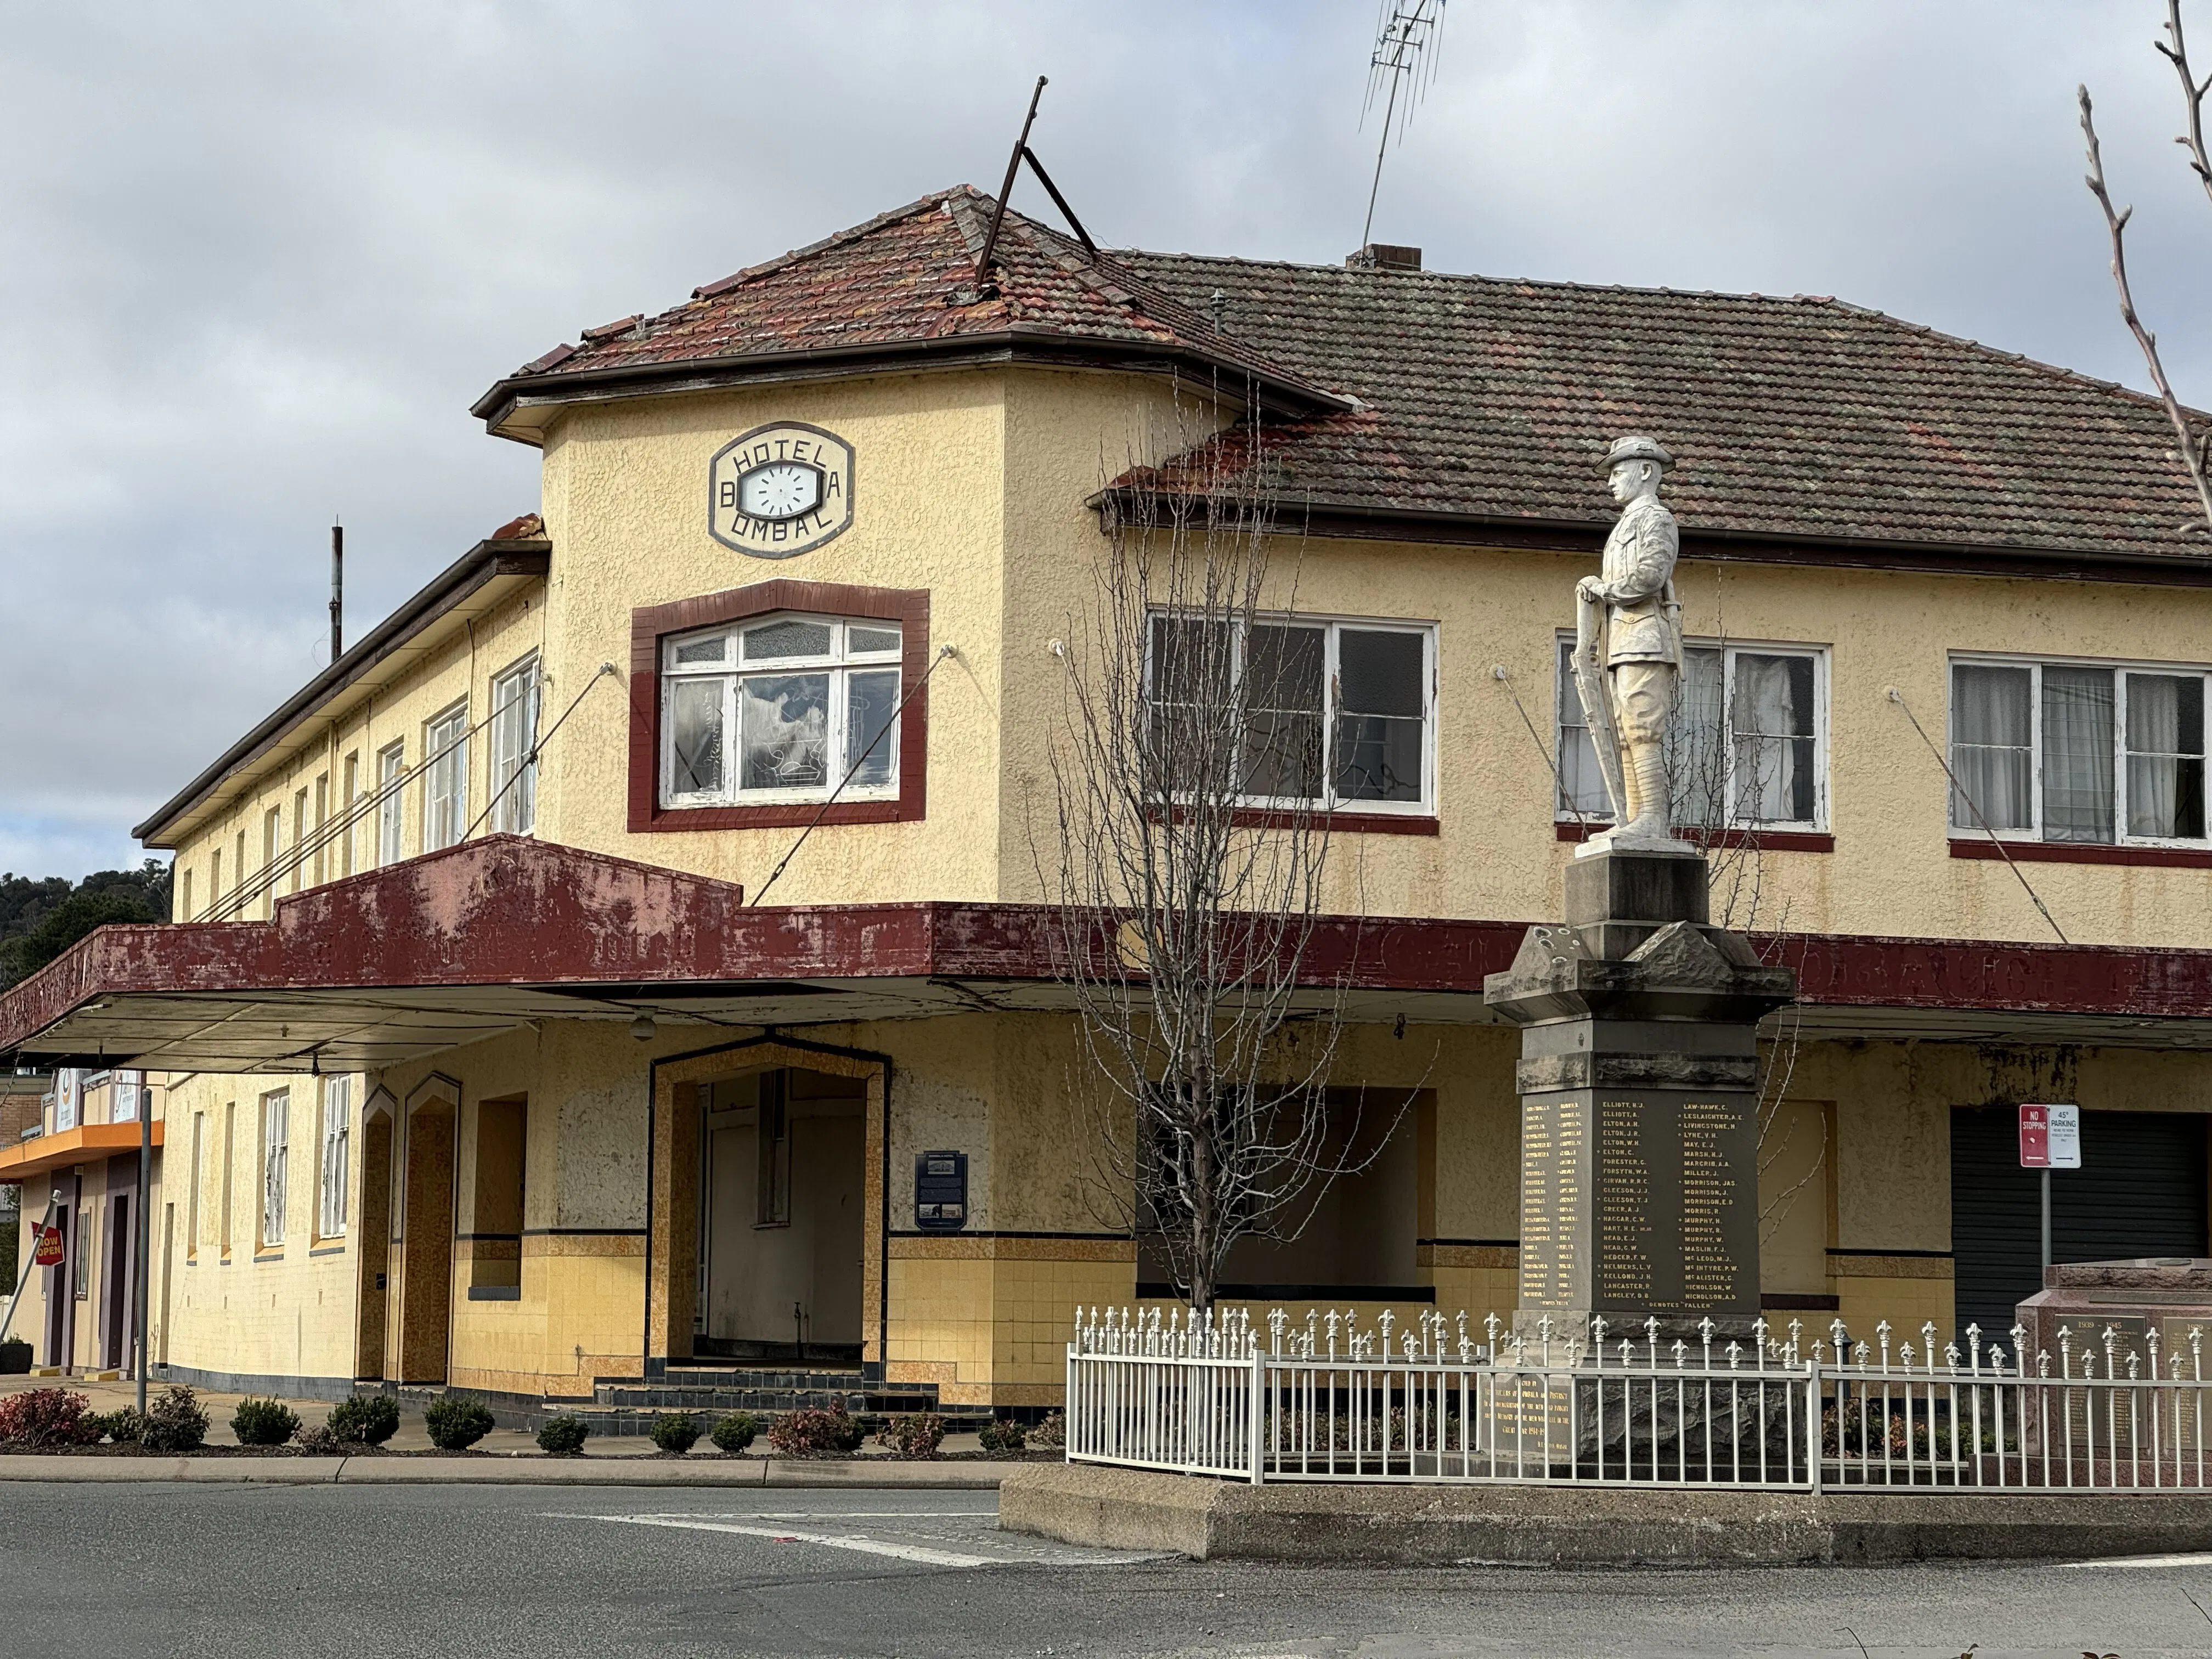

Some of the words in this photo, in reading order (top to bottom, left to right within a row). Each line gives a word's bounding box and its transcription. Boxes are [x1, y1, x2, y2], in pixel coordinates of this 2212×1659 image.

[733, 439, 826, 474] HOTEL
[721, 471, 840, 541] BOMBALA
[2030, 1111, 2039, 1120] NO
[2023, 1121, 2046, 1130] STOPPING
[37, 1245, 60, 1256] OPEN
